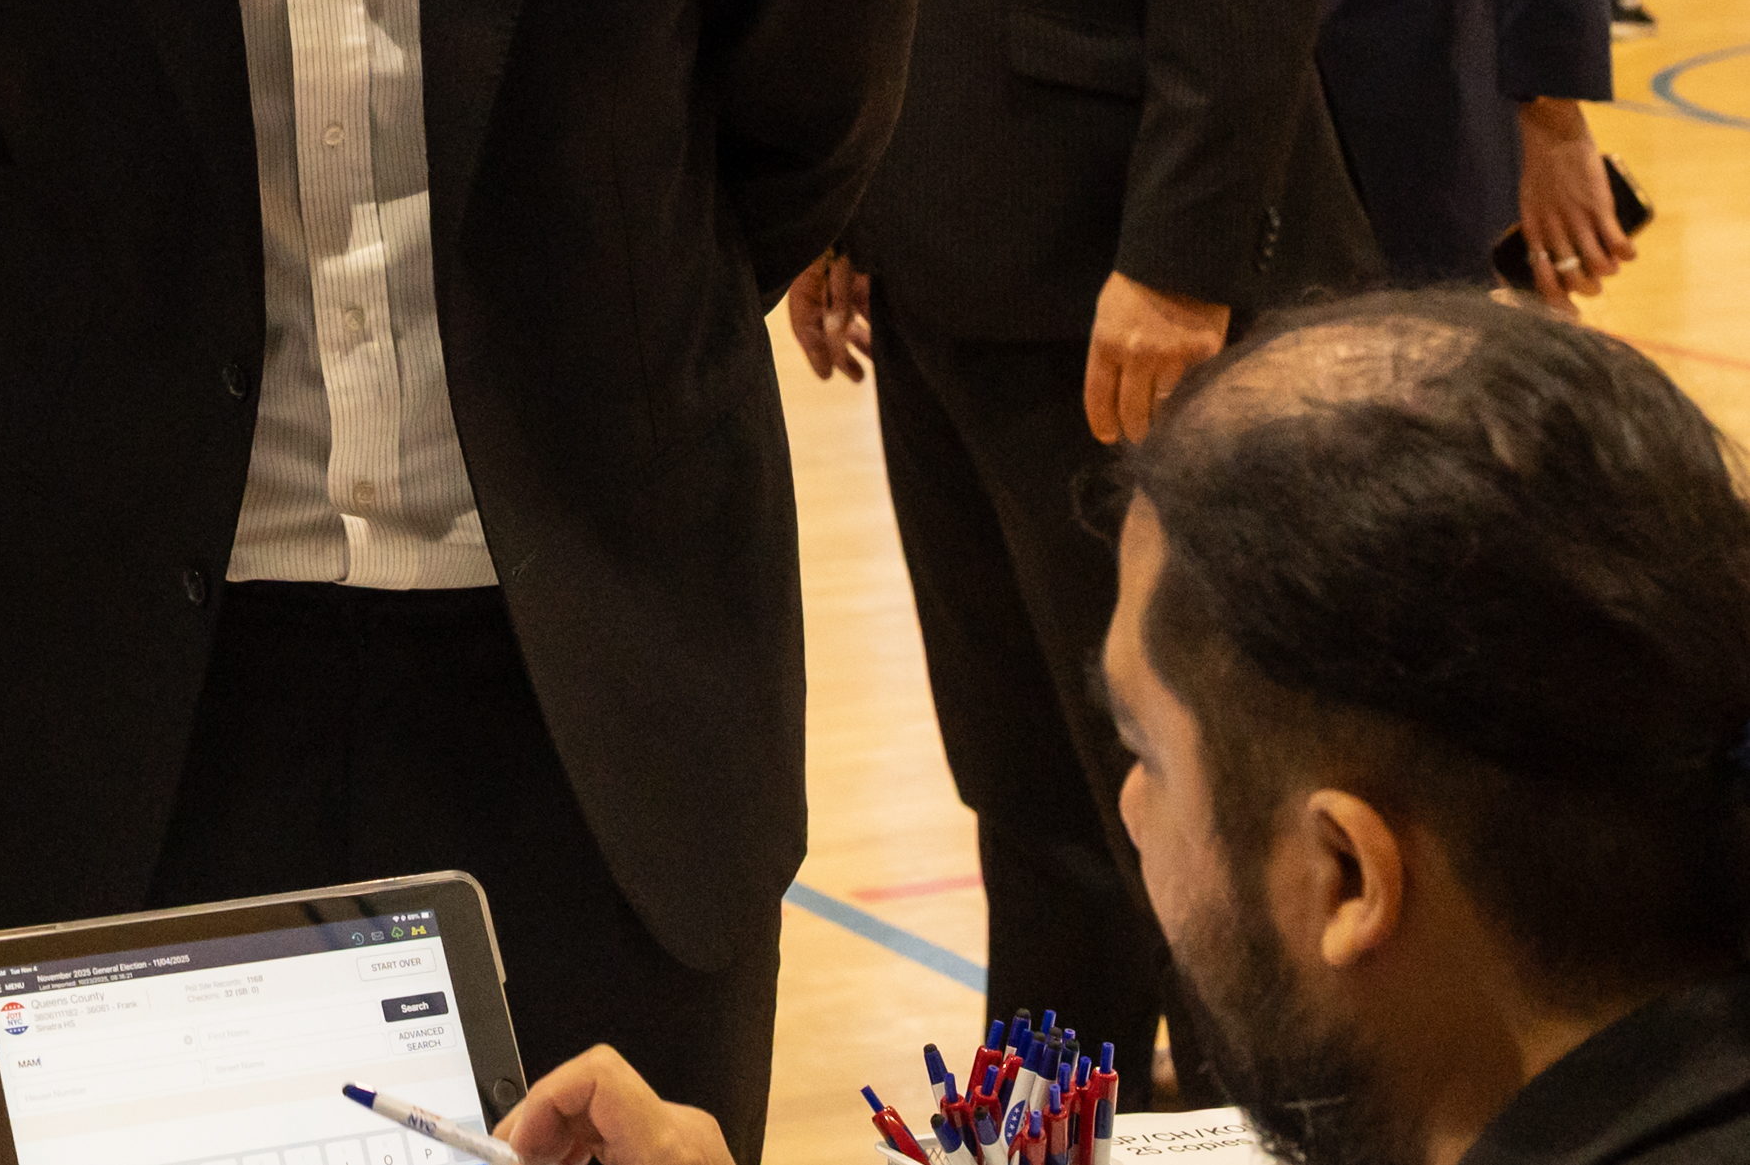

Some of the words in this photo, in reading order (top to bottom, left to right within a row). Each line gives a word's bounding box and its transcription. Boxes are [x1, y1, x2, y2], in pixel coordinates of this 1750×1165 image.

[36, 971, 72, 983] November
[73, 968, 91, 978] 2025
[92, 963, 119, 975] General
[119, 960, 147, 972] Election
[152, 954, 190, 967] 11/04/2025
[371, 961, 397, 972] START
[399, 957, 422, 968] OVER
[5, 982, 25, 991] MENU
[38, 983, 51, 991] Last
[198, 983, 212, 991] Site
[247, 974, 264, 984] 1168
[224, 989, 233, 998] 32
[31, 997, 68, 1010] Queens
[70, 991, 104, 1005] County
[117, 1001, 137, 1010] Frank
[400, 1001, 429, 1014] Search
[8, 1018, 23, 1026] NYC
[36, 1022, 62, 1033] Sinatra
[64, 1019, 76, 1028] HS
[399, 1026, 444, 1041] ADVANCED
[406, 1039, 441, 1052] SEARCH
[17, 1058, 41, 1068] MAM
[425, 1148, 432, 1159] P
[1127, 1145, 1162, 1156] 25
[1167, 1138, 1254, 1152] copies
